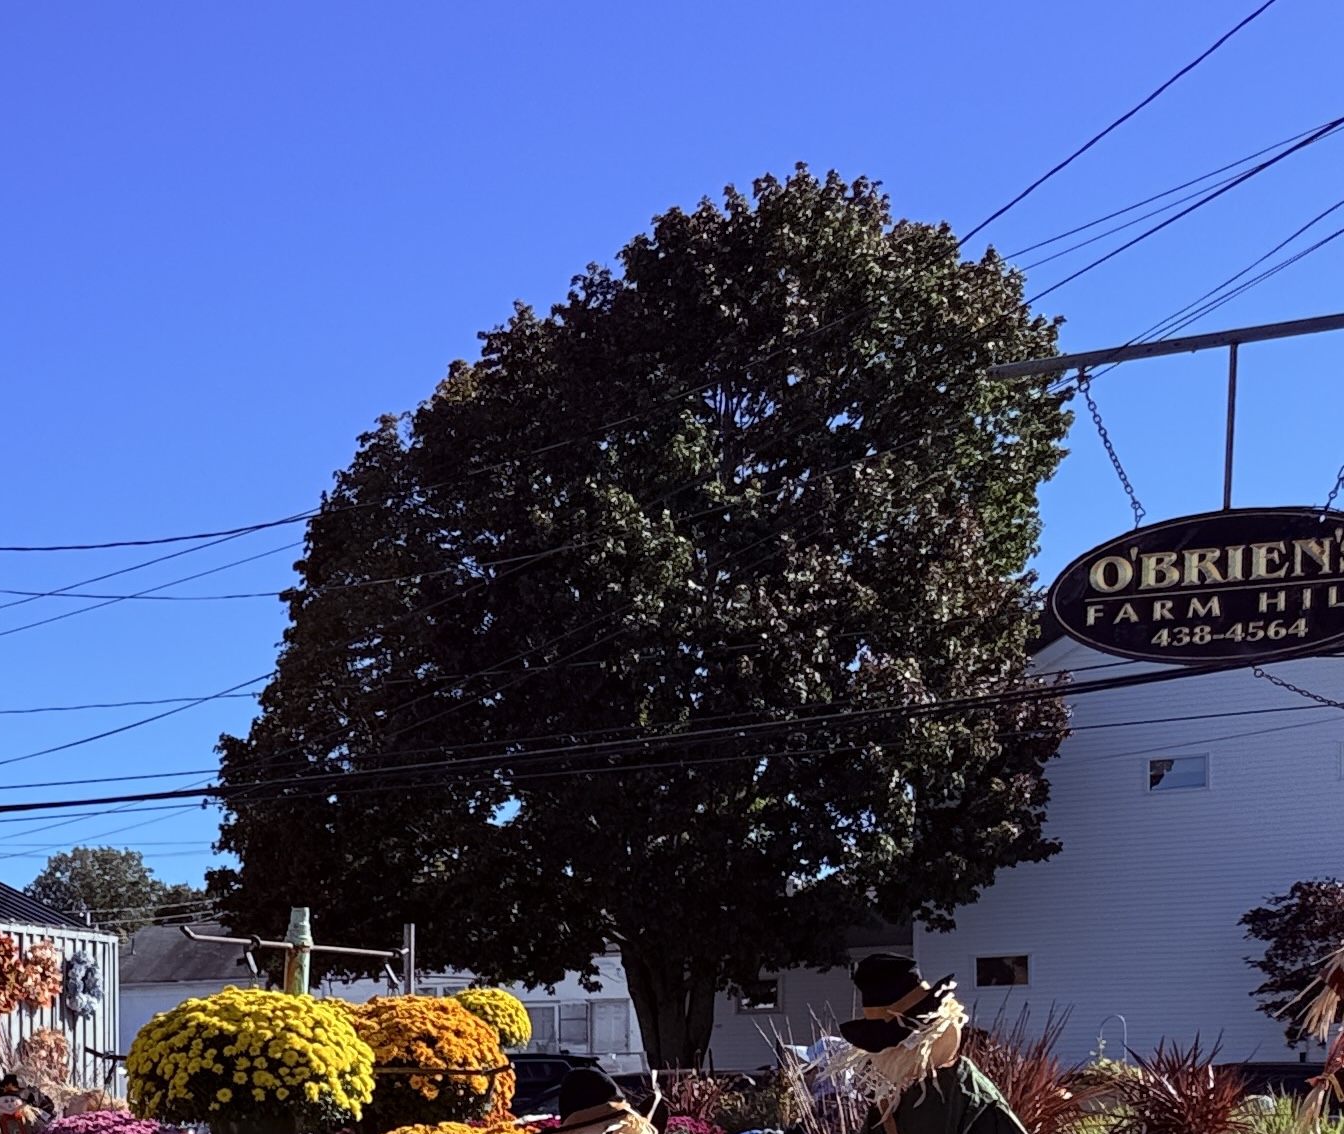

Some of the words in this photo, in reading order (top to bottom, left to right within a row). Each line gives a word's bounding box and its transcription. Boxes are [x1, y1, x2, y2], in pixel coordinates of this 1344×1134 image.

[1089, 527, 1344, 593] O'BRIEN'
[1086, 595, 1221, 627] FARM
[1150, 617, 1309, 648] 438-4564
